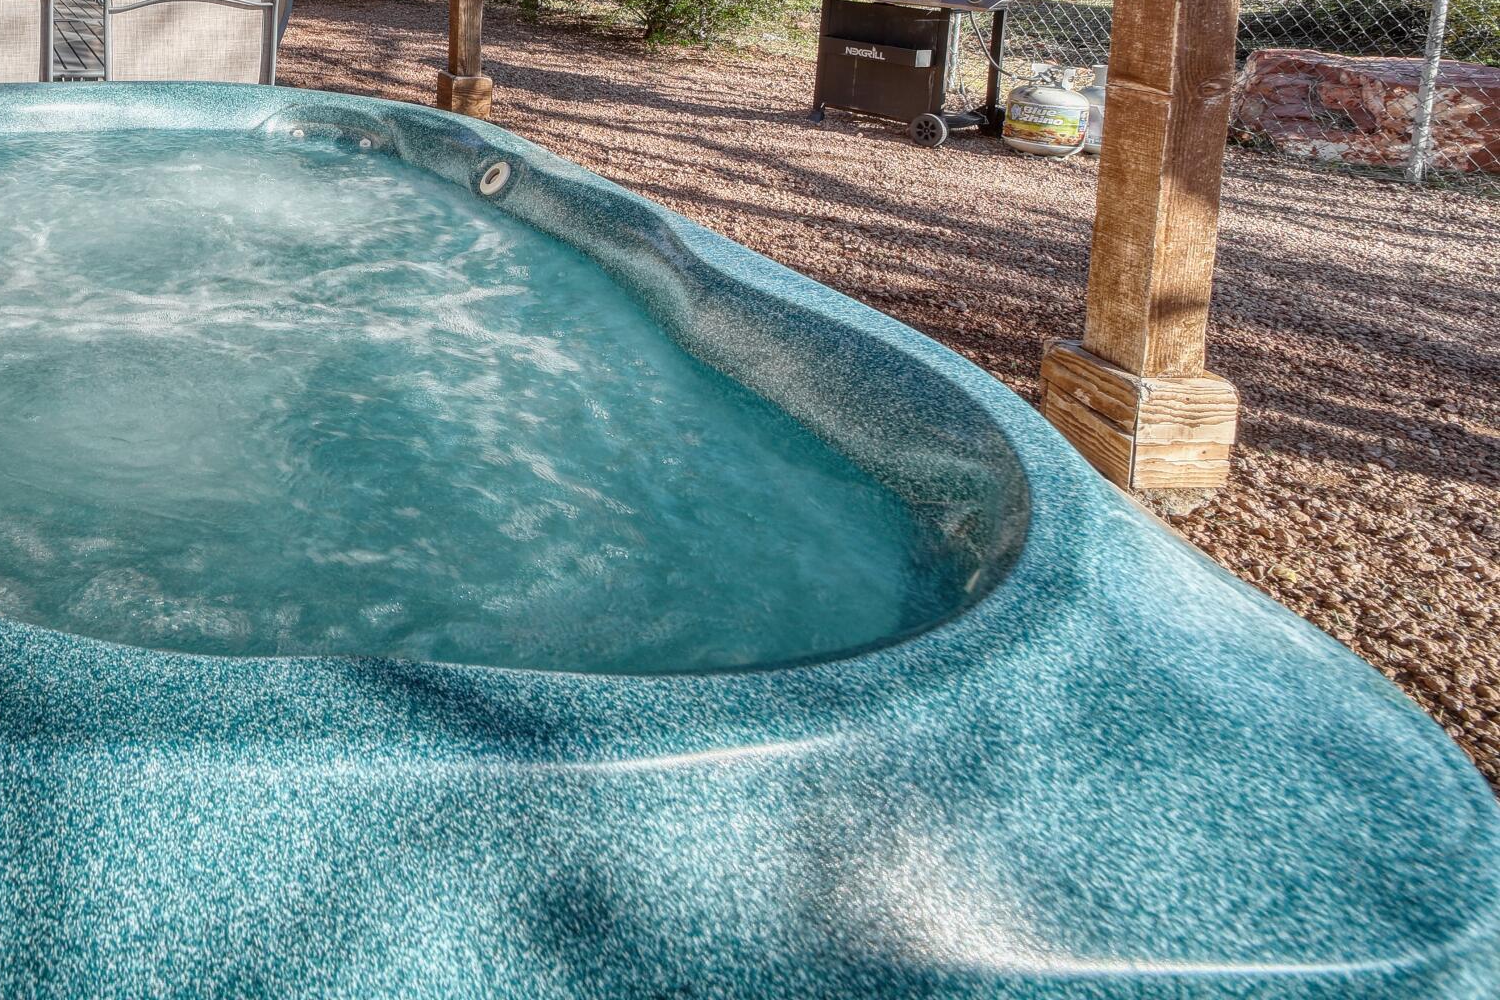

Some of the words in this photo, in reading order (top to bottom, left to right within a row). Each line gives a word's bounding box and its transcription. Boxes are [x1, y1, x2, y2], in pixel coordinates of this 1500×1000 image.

[845, 45, 886, 61] NEXGRILL
[1023, 105, 1058, 117] Blue
[1019, 113, 1065, 126] Rhino
